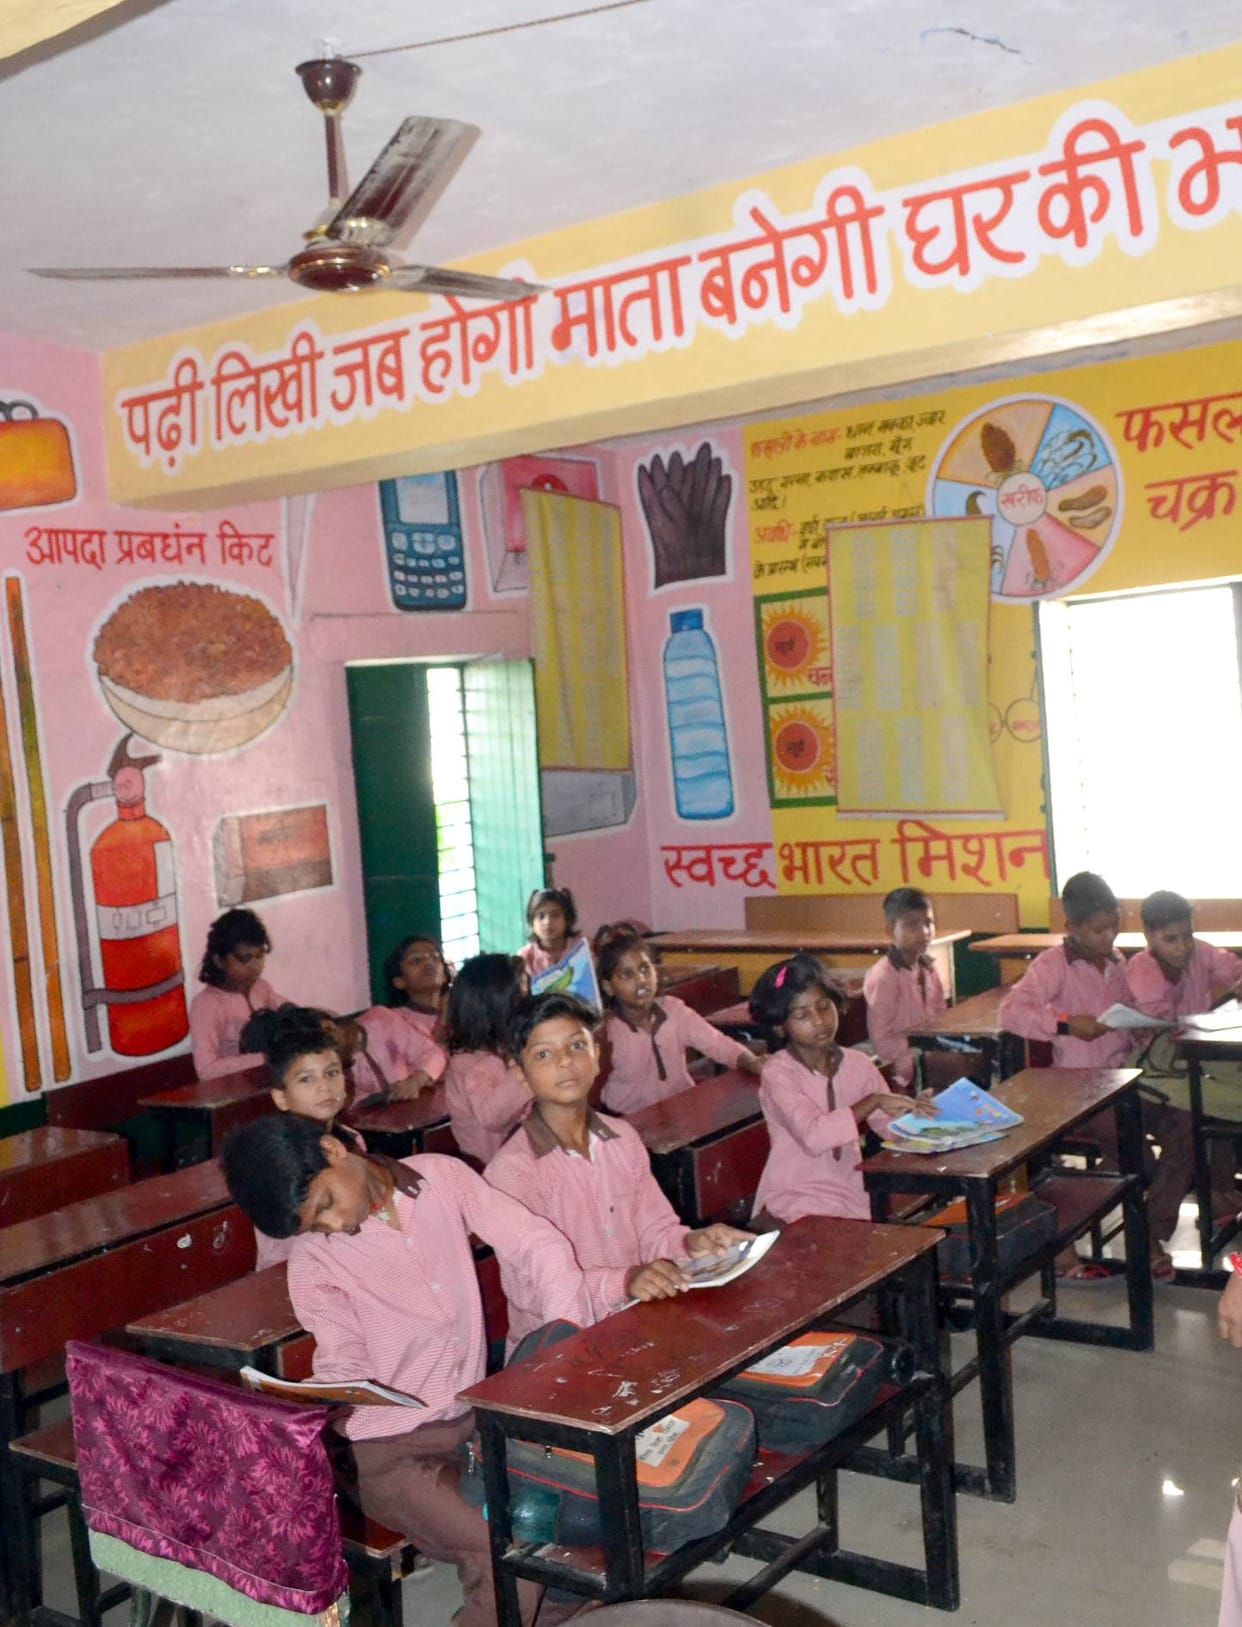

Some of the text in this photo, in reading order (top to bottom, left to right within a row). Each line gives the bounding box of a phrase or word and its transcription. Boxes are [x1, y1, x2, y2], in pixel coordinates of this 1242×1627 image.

[121, 357, 204, 468] पढ़ी
[211, 331, 325, 440] लिखी
[331, 328, 410, 411] जब
[551, 258, 692, 357] माता
[698, 185, 884, 324] बनेगी
[902, 170, 1031, 277] घर
[1038, 118, 1146, 248] की
[1145, 470, 1238, 532] चक्र
[24, 526, 107, 570] आपदा
[217, 520, 275, 567] किट
[660, 819, 1051, 889] स्वच्छ भारत मिशन
